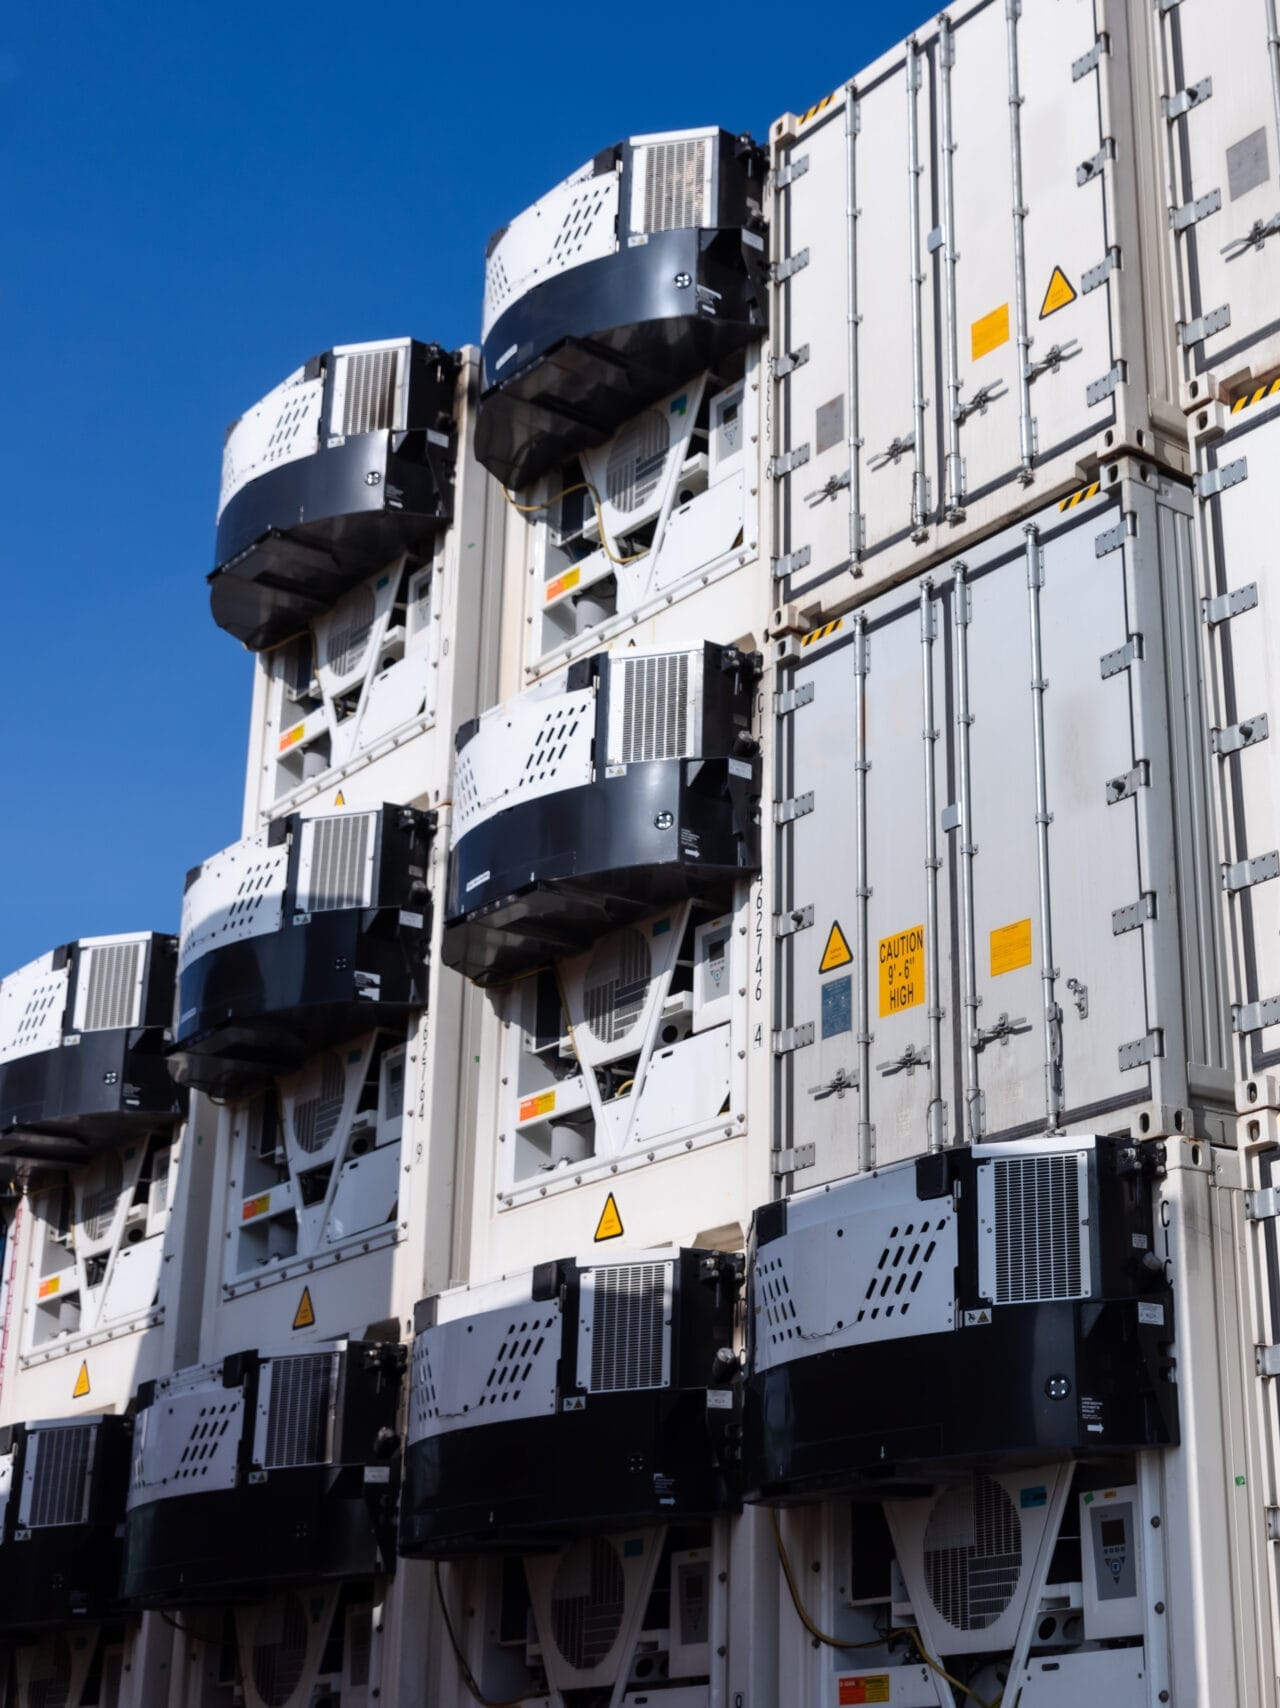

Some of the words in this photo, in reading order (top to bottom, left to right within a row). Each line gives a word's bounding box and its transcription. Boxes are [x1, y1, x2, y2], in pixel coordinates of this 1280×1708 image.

[755, 868, 763, 1001] 462746
[880, 929, 923, 963] CAUTION
[889, 982, 914, 1010] HIGH
[754, 1024, 762, 1047] 4
